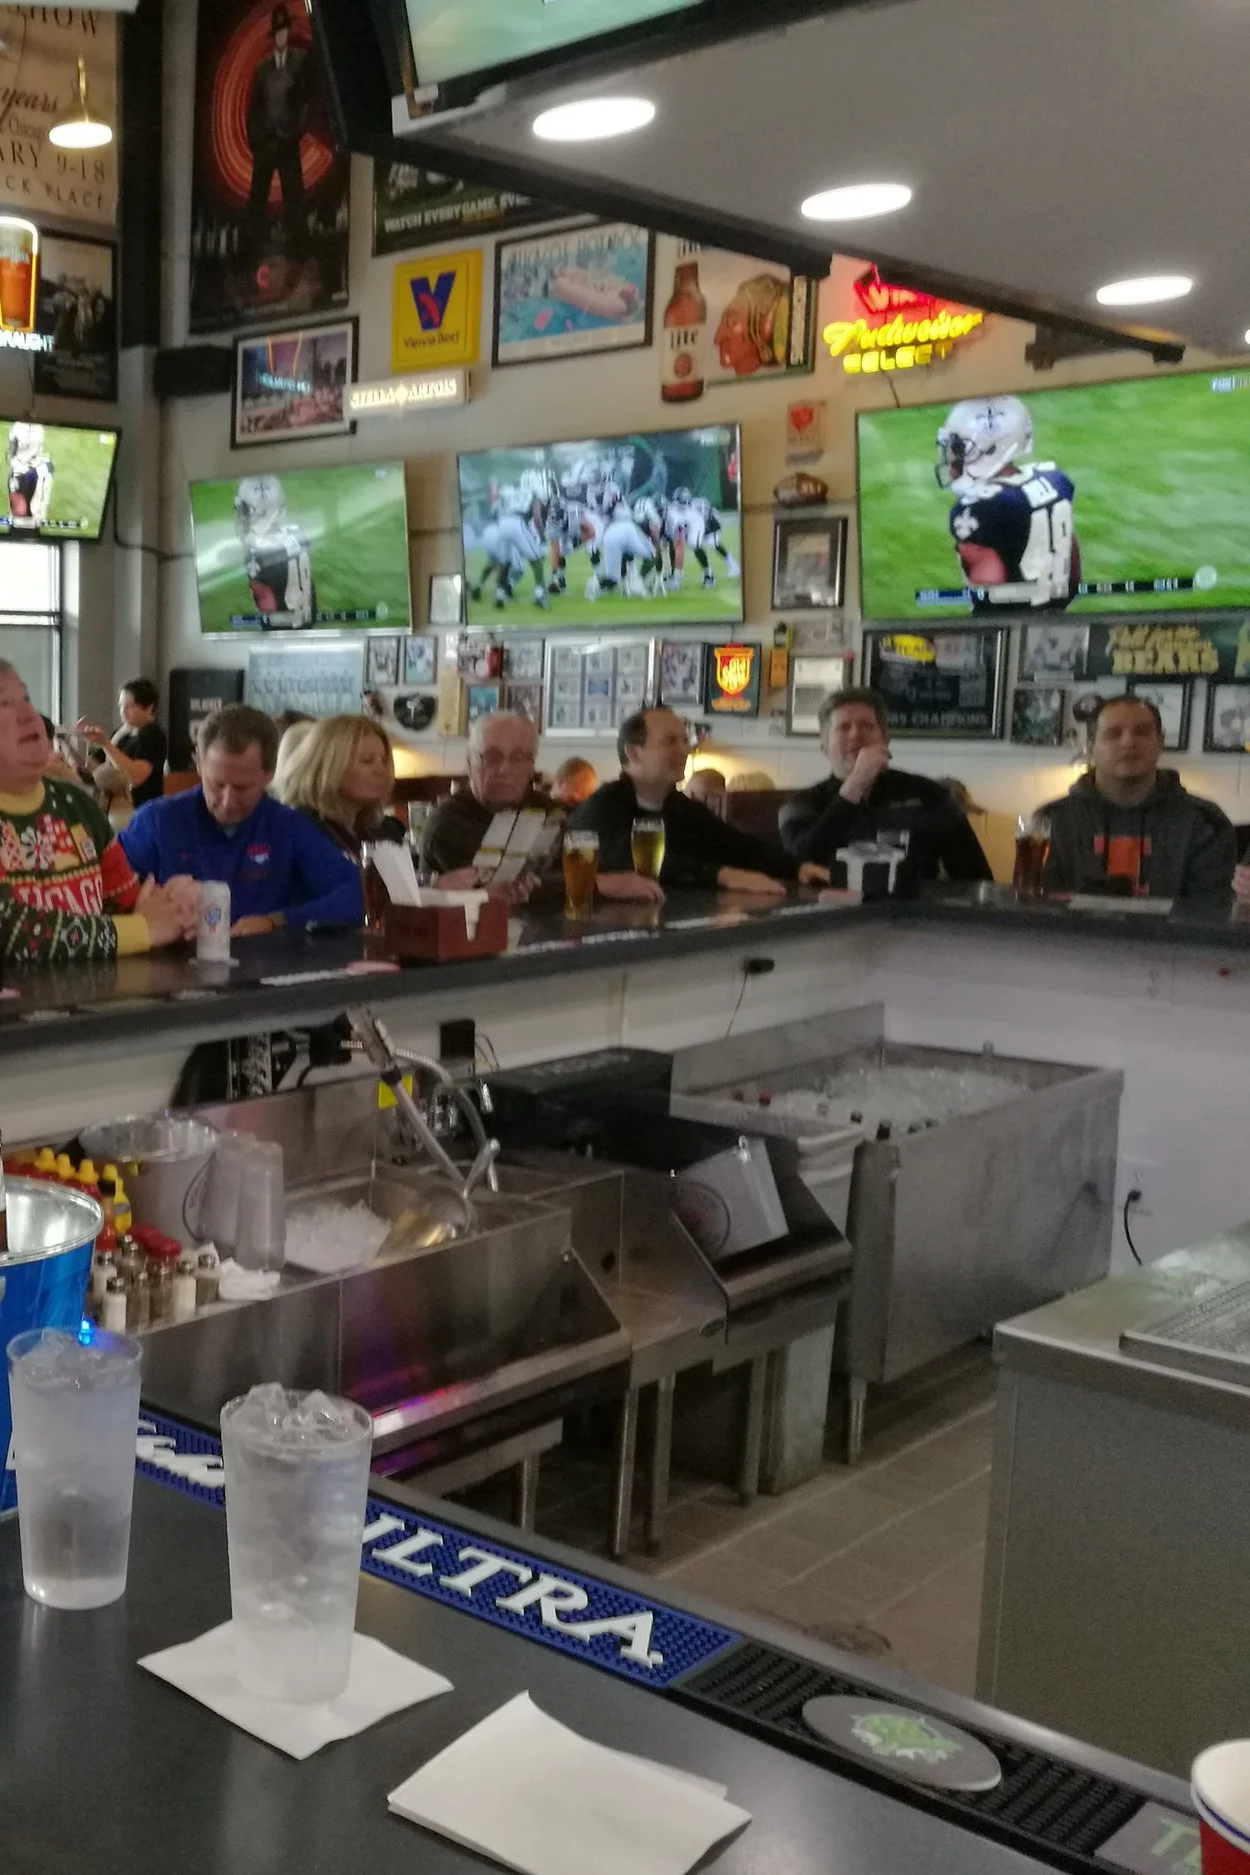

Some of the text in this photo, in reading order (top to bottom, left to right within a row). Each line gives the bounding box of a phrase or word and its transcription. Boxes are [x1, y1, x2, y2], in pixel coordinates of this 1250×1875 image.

[56, 152, 106, 184] 9-18
[45, 181, 104, 210] PLACE
[384, 211, 422, 233] WATCH
[424, 203, 461, 227] EVERY
[404, 334, 436, 349] Vienna
[822, 310, 983, 357] Budweiser
[350, 377, 457, 409] STELLA ARTOIS
